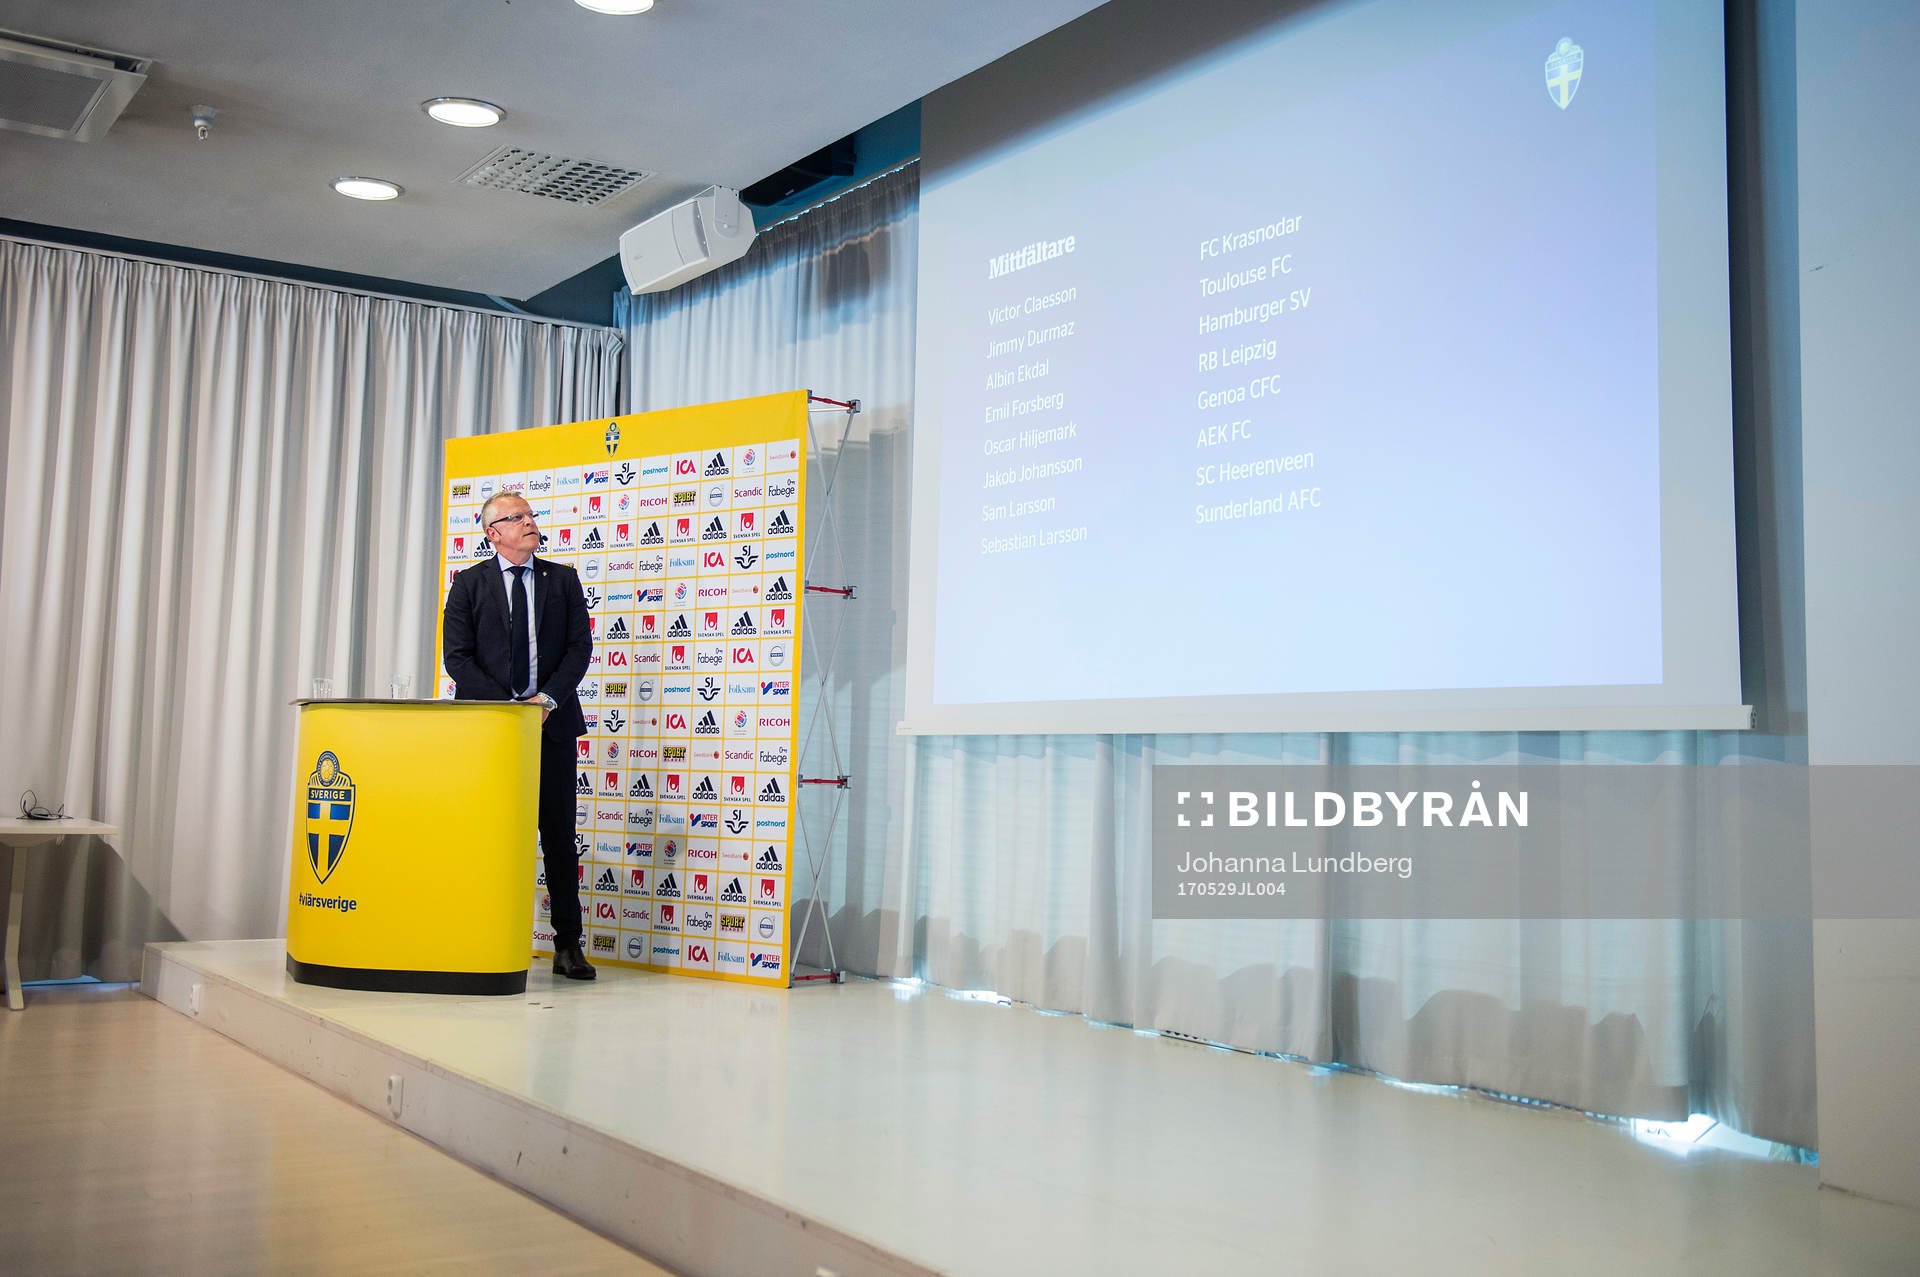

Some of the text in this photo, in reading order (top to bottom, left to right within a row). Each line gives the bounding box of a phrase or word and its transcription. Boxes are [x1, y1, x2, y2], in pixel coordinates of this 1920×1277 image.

[1200, 215, 1301, 260] FC Krasnodar
[988, 234, 1076, 280] Mittfältare
[1200, 254, 1292, 298] Toulouse FC
[988, 286, 1076, 326] Victor Claesson
[1199, 288, 1312, 335] Hamburger SV
[987, 321, 1075, 359] Jimmy Durmaz
[1199, 338, 1277, 372] RB Leipzig
[986, 359, 1049, 391] Albin Ekdal
[1198, 374, 1281, 409] Genoa CFC
[985, 391, 1064, 423] Emil Forsberg
[984, 421, 1077, 456] Oscar Hiljemark
[1198, 420, 1251, 448] AEK FC
[622, 463, 630, 473] SJ
[642, 466, 668, 475] postnord
[676, 460, 696, 475] ICA
[705, 467, 729, 476] adidas
[984, 455, 1082, 488] Jakob Johansson
[1196, 450, 1314, 486] SC Heerenveen
[453, 485, 470, 495] SPORT
[502, 482, 525, 491] Scandic
[530, 481, 551, 491] Fabege
[674, 492, 696, 502] SPORT
[734, 487, 762, 498] Scandic
[769, 486, 795, 498] Fabege
[641, 498, 667, 506] RICOH
[1196, 487, 1321, 524] Sunderland AFC
[982, 495, 1055, 522] Sam Larsson
[702, 531, 727, 540] adidas
[768, 526, 793, 535] adidas
[641, 536, 664, 545] adidas
[981, 524, 1088, 555] Sebastian Larsson
[742, 545, 750, 556] SJ
[766, 551, 794, 560] postnord
[669, 558, 694, 567] Folksam
[704, 552, 724, 567] ICA
[609, 562, 634, 571] Scandic
[639, 560, 662, 573] Fabege
[588, 587, 595, 597] SJ
[698, 588, 727, 597] RICOH
[766, 592, 792, 601] adidas
[607, 631, 629, 639] adidas
[668, 629, 691, 637] adidas
[732, 626, 756, 635] adidas
[608, 652, 627, 666] ICA
[634, 654, 660, 663] Scandic
[698, 652, 722, 665] Fabege
[733, 648, 754, 664] ICA
[705, 677, 713, 688] SJ
[606, 683, 627, 694] SPORT
[728, 685, 755, 693] Folksam
[612, 710, 619, 720] SJ
[666, 714, 686, 729] ICA
[759, 718, 790, 727] RICOH
[695, 725, 719, 734] adidas
[630, 750, 657, 758] RICOH
[664, 747, 686, 758] SPORT
[725, 751, 753, 759] Scandic
[760, 753, 787, 765] Fabege
[311, 790, 345, 799] SVERIGE
[630, 790, 653, 798] adidas
[693, 792, 717, 800] adidas
[759, 794, 785, 802] adidas
[598, 811, 622, 821] Scandic
[628, 812, 653, 827] Fabege
[659, 815, 684, 824] Folksam
[733, 810, 741, 820] SJ
[700, 820, 717, 828] SPORT
[597, 843, 621, 853] Folksam
[688, 850, 716, 859] RICOH
[756, 861, 782, 870] adidas
[595, 882, 618, 892] adidas
[657, 887, 680, 897] adidas
[721, 892, 746, 903] adidas
[597, 903, 616, 919] ICA
[623, 909, 649, 919] Scandic
[687, 916, 712, 931] Fabege
[721, 916, 745, 927] SPORT
[593, 936, 615, 947] SPORT
[653, 947, 679, 955] postnord
[688, 945, 709, 963] ICA
[718, 952, 744, 963] Folksam
[763, 954, 780, 962] INTER
[762, 961, 780, 970] SPORT
